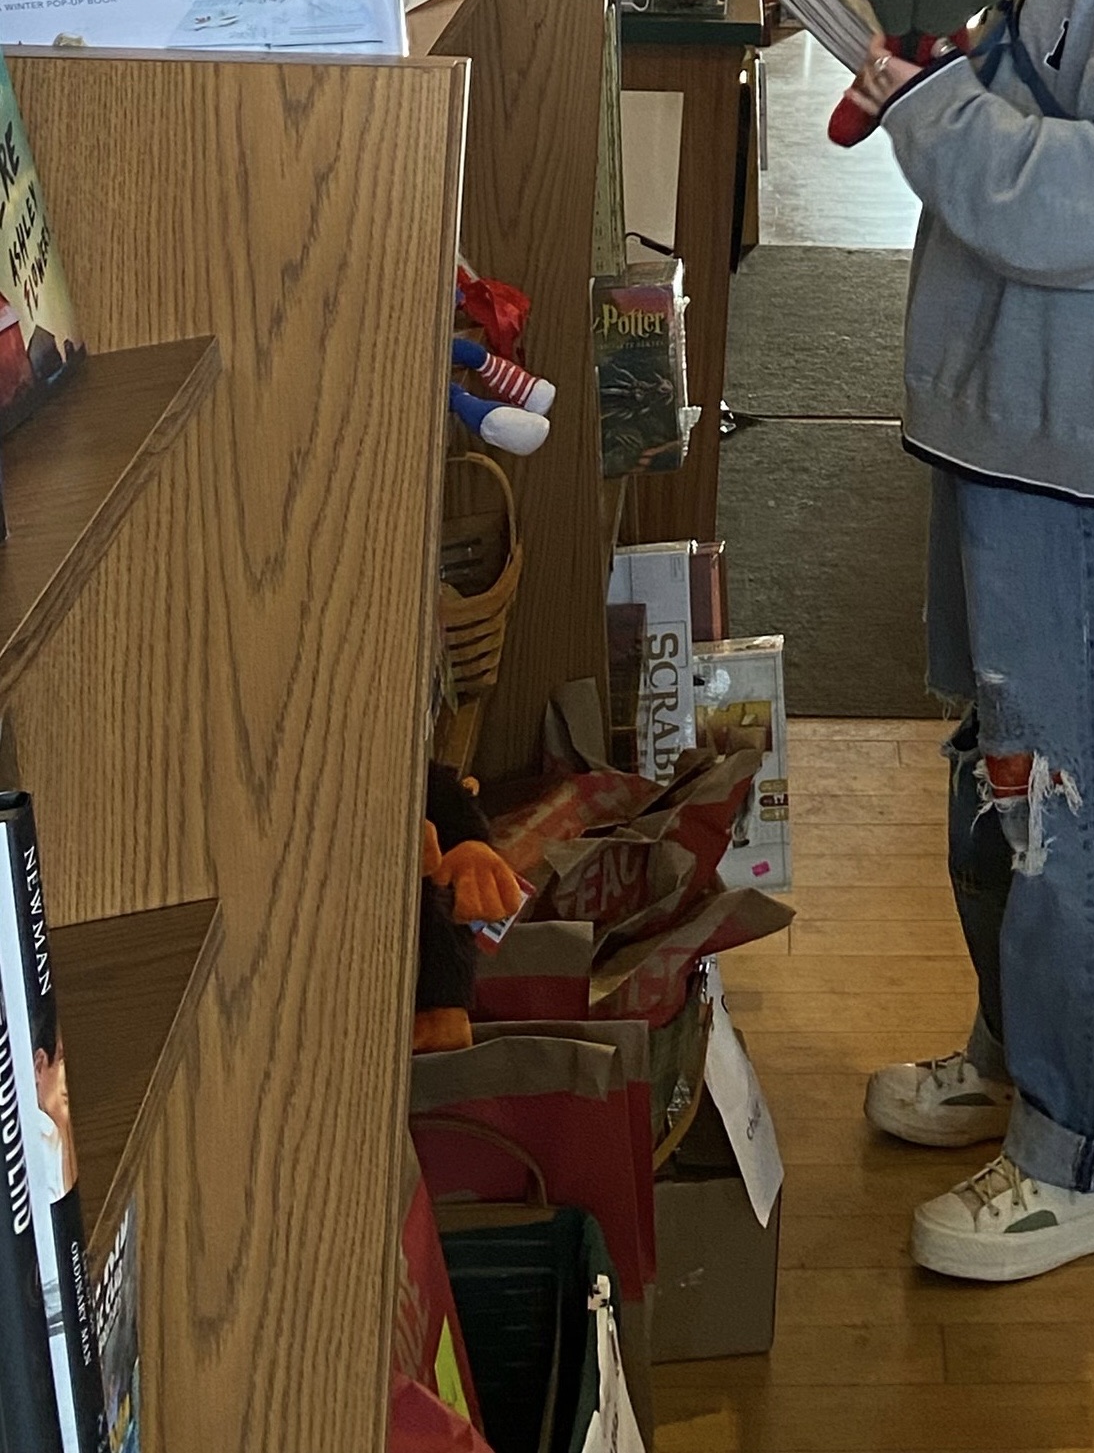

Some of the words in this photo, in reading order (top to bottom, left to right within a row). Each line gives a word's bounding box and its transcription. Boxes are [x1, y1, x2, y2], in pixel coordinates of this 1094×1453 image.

[4, 0, 44, 12] WINTER
[8, 181, 38, 288] ASHLEY
[597, 303, 666, 342] Potter
[23, 845, 52, 997] NEWMAN
[71, 1241, 87, 1323] ORDINARY
[80, 1327, 92, 1367] MAN
